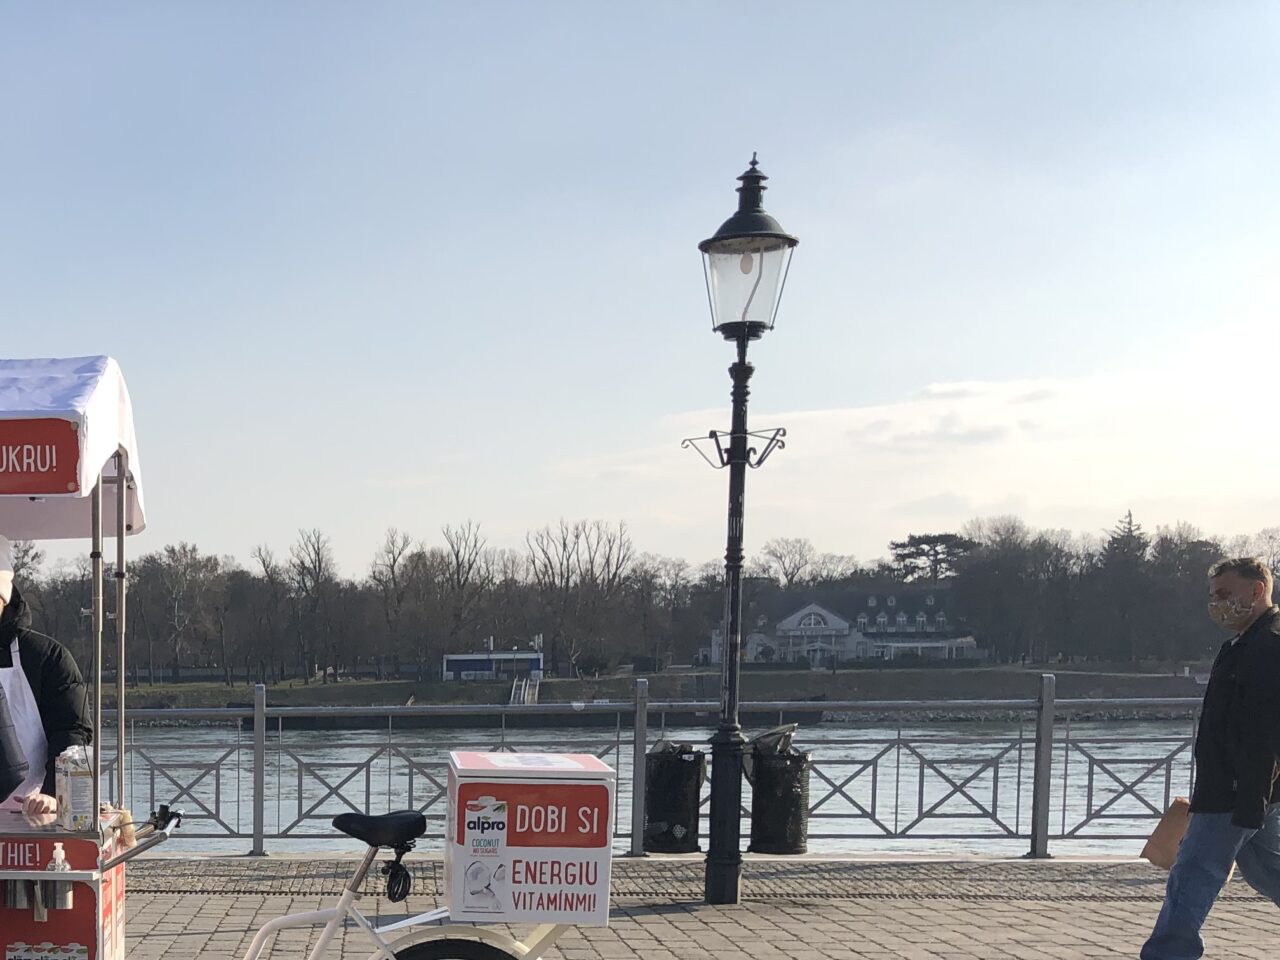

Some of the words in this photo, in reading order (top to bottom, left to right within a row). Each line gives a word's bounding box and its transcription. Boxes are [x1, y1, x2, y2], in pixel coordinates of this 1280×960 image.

[467, 816, 506, 834] alpro
[516, 805, 566, 833] DOBI
[578, 807, 599, 834] SI
[472, 838, 500, 848] COCONUT
[512, 860, 598, 886] ENERGIU
[512, 890, 597, 913] VITAMÍNMI!
